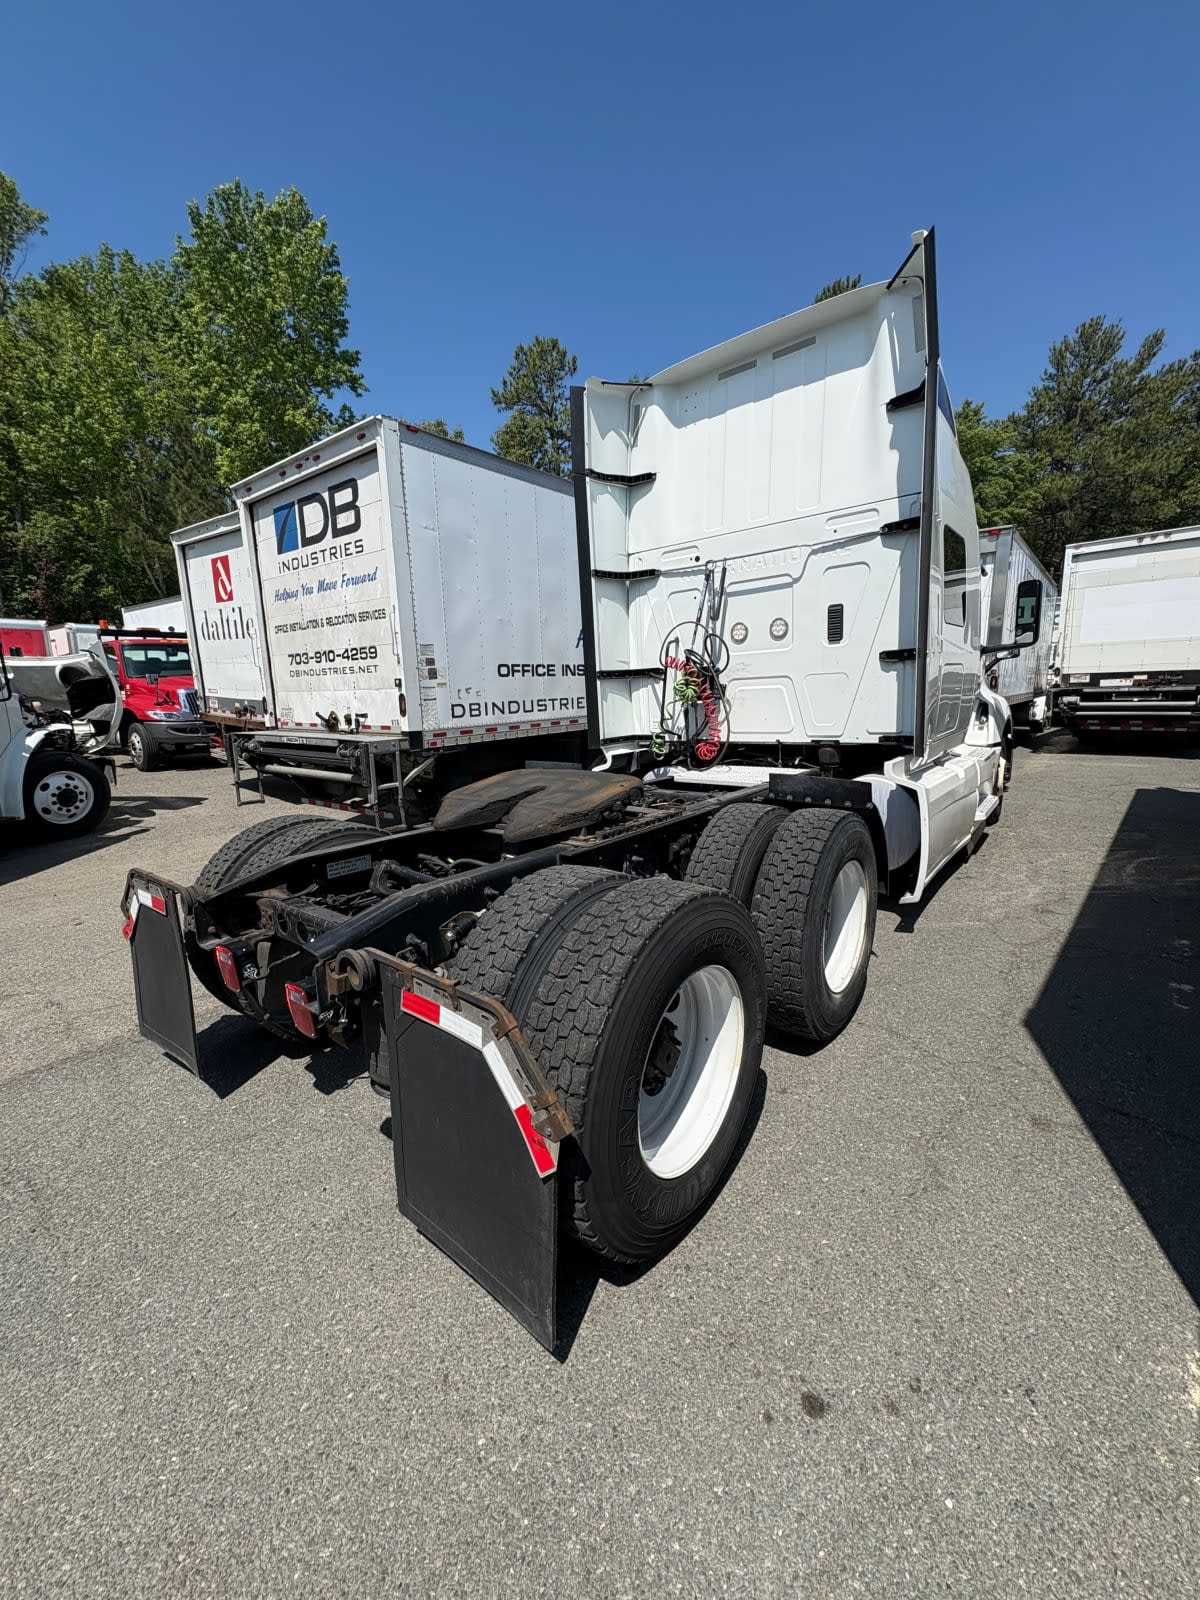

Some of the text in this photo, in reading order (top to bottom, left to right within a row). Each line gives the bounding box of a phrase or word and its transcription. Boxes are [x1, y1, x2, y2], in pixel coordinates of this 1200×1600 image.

[274, 566, 378, 602] Helping You Move Forward
[201, 606, 257, 641] daltile
[274, 623, 289, 634] OFFICE
[290, 619, 320, 632] INSTALLATION
[325, 613, 357, 627] RELOCATION
[358, 608, 387, 622] SERVICES
[288, 646, 378, 665] 703-910-4259
[289, 664, 379, 678] DBINDUSTRIES.NET
[497, 663, 556, 677] OFFICE
